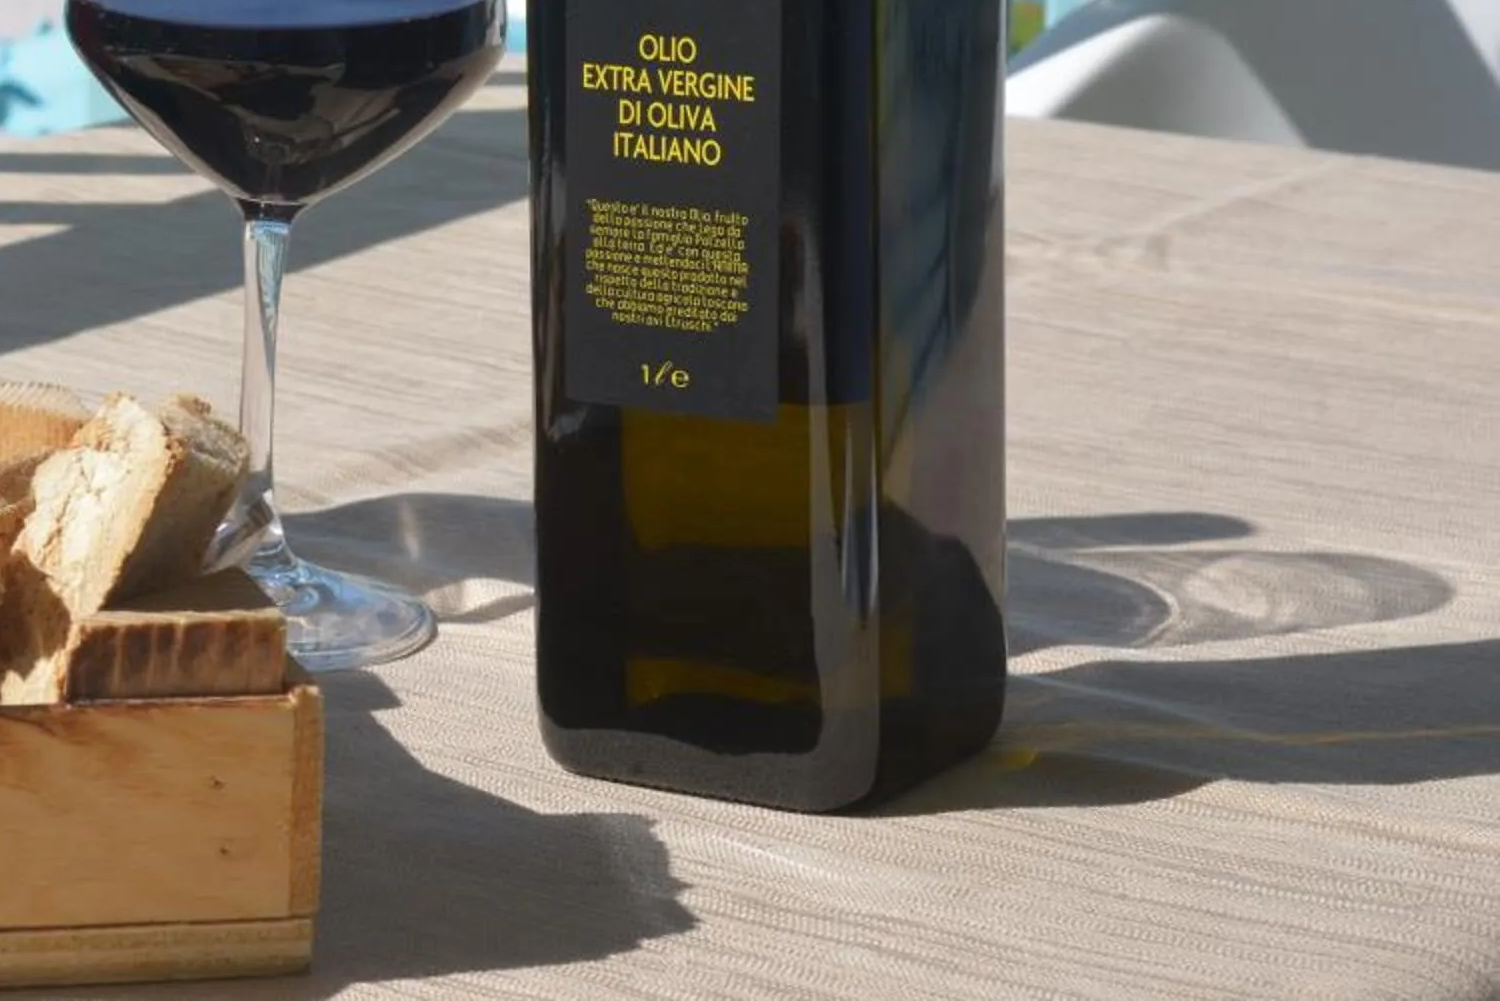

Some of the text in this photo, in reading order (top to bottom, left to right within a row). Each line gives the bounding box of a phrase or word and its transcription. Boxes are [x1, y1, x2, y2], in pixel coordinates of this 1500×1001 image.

[638, 34, 698, 64] OLIO
[582, 62, 756, 103] EXTRA VERGINE
[618, 98, 718, 133] DI OLIVA
[613, 131, 722, 167] ITALIANO
